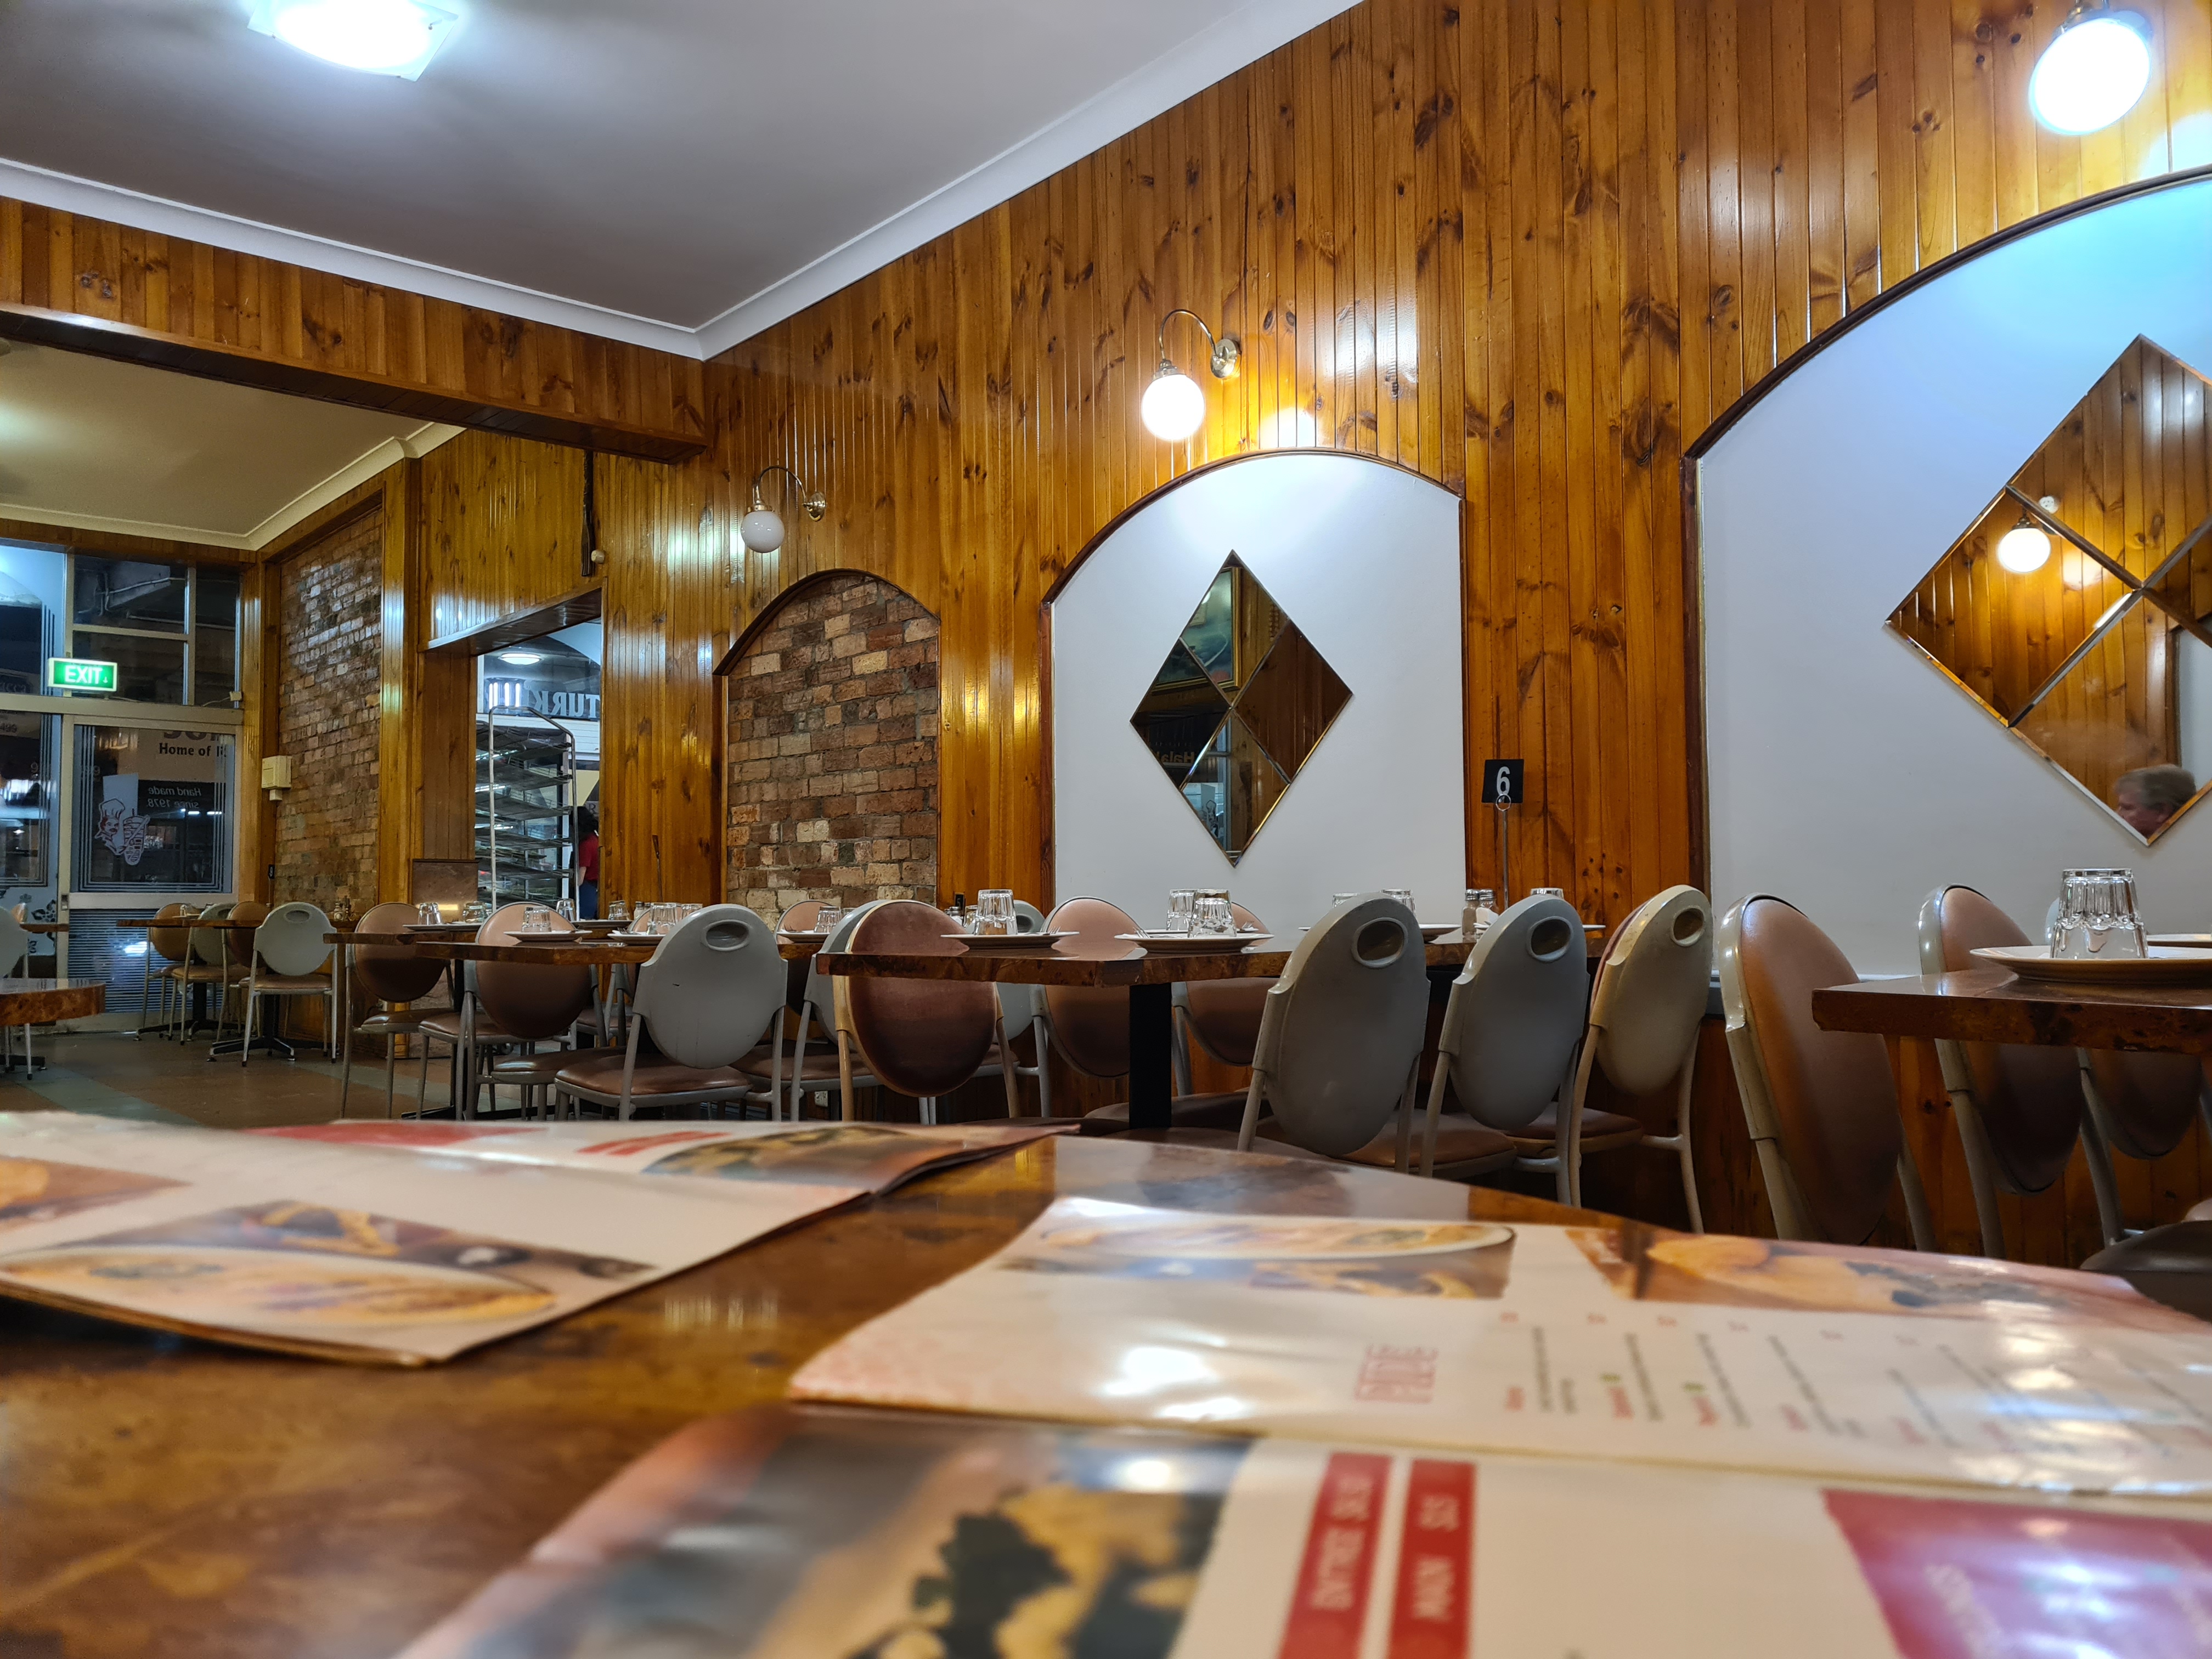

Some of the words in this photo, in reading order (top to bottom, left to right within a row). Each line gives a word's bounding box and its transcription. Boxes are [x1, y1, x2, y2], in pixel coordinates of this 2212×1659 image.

[65, 664, 103, 684] EXIT
[159, 743, 194, 755] Home
[198, 746, 211, 756] of
[1497, 766, 1510, 795] 6
